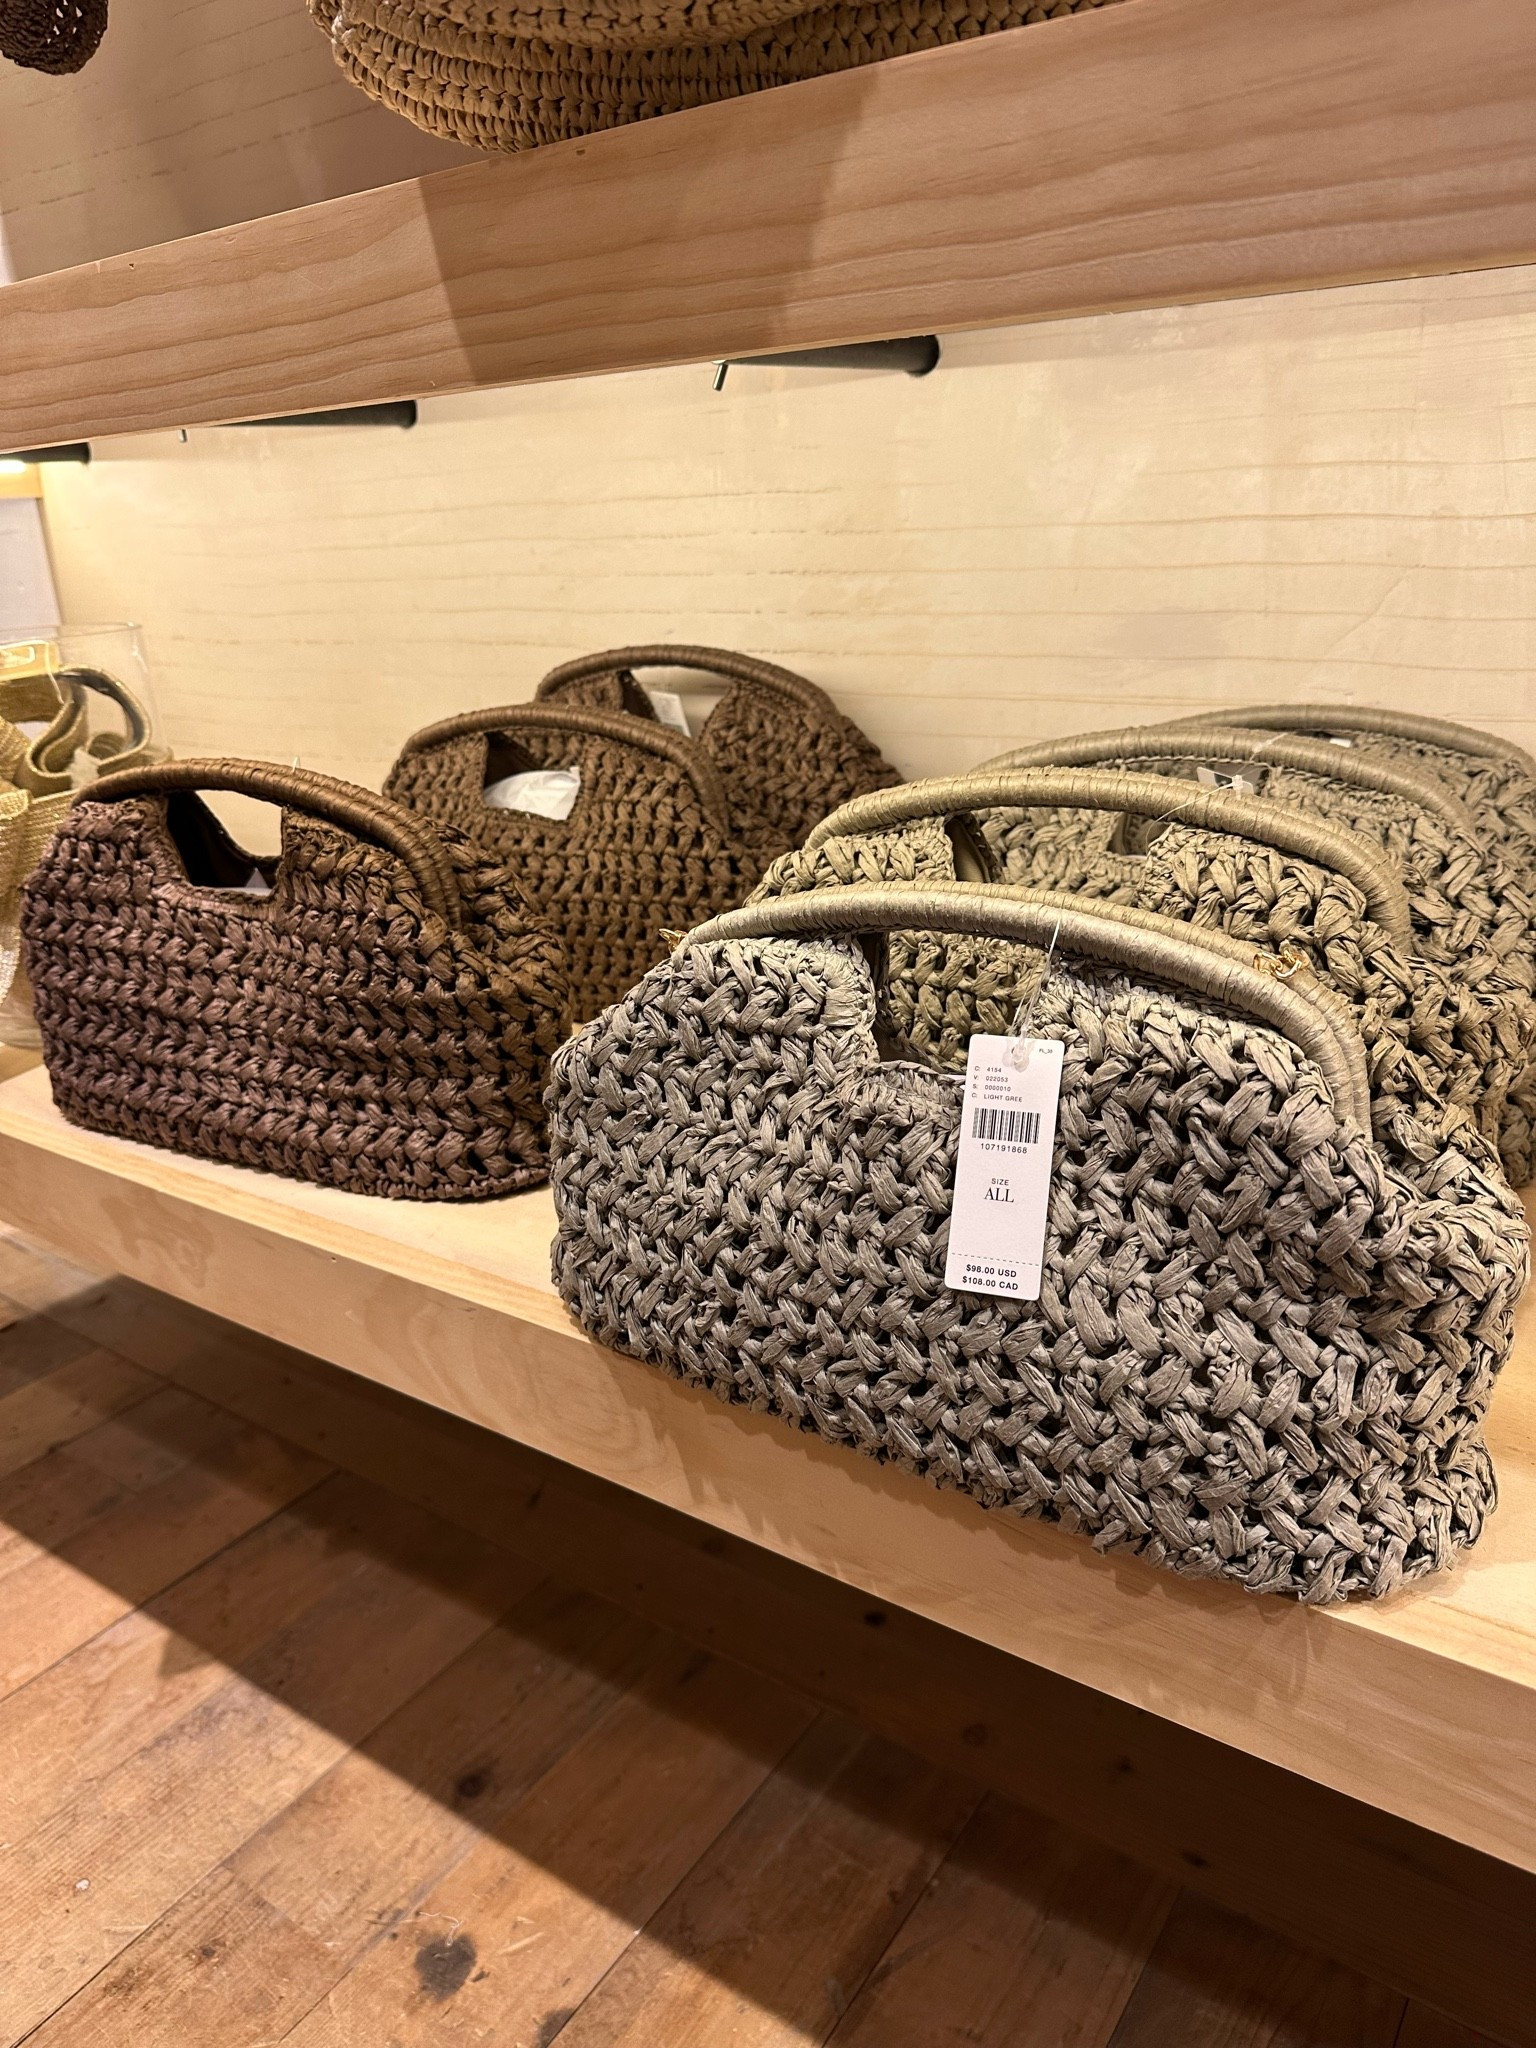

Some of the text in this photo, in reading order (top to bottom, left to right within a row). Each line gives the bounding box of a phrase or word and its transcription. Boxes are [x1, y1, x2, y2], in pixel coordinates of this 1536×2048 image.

[981, 1143, 1027, 1154] 107191868
[991, 1178, 1009, 1186] SIZE
[984, 1187, 1014, 1203] ALL
[966, 1264, 1017, 1278] $98.00 USD
[962, 1275, 1018, 1291] $108.00 CAD
